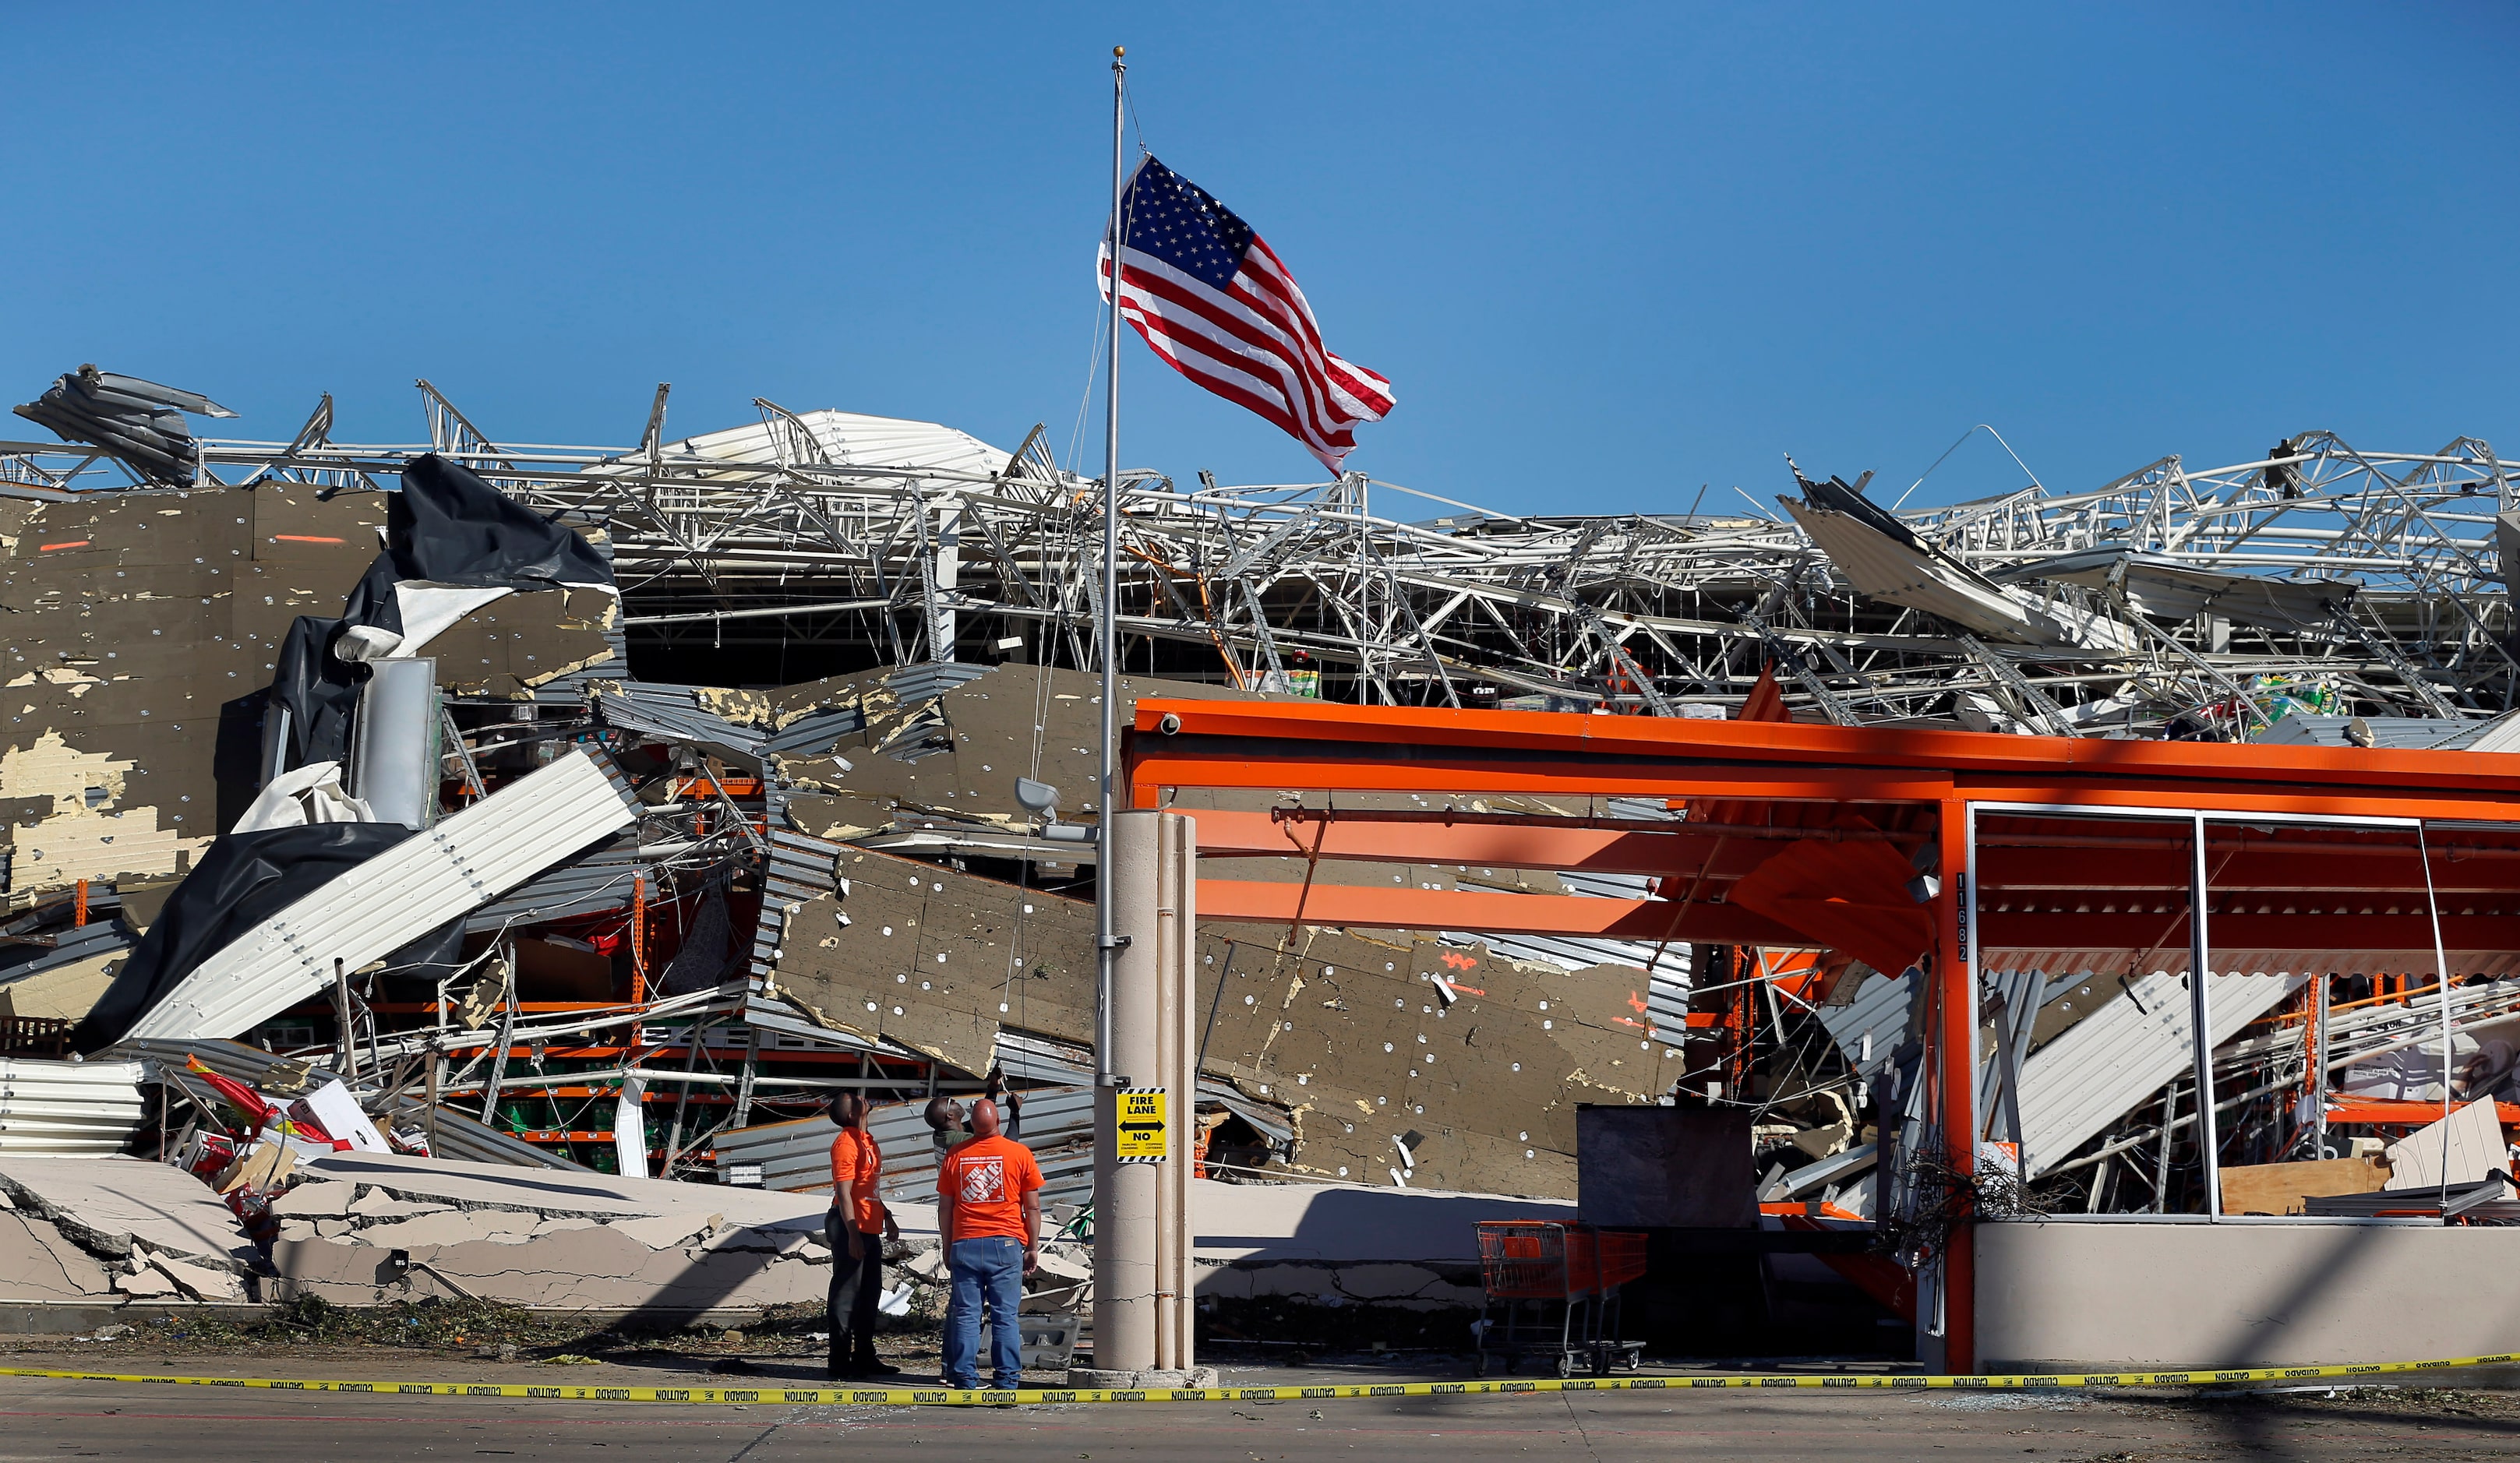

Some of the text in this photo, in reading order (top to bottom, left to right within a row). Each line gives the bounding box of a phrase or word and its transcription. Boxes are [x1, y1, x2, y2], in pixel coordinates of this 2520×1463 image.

[962, 1163, 1000, 1201] HOME
[965, 1166, 982, 1183] THE
[977, 1176, 1002, 1201] DEPOT
[339, 1384, 372, 1392] CUIDADO
[399, 1385, 432, 1394] CAUTION
[468, 1387, 501, 1396] CUIDADO
[528, 1387, 560, 1398] CAUTION
[596, 1389, 630, 1399] CUIDADO
[656, 1390, 689, 1400] CAUTION
[725, 1391, 758, 1401] CUIDADO
[785, 1391, 817, 1401] CAUTION
[853, 1392, 887, 1402] CUIDADO
[913, 1392, 947, 1401] CAUTION
[982, 1392, 1016, 1401] CUIDADO
[1043, 1392, 1075, 1401] CAUTION
[1111, 1391, 1145, 1401] CUIDADO
[1172, 1391, 1205, 1401] CAUTION
[1241, 1390, 1275, 1399] CUIDADO
[1301, 1388, 1335, 1398] CAUTION
[1371, 1387, 1404, 1396] CUIDADO
[1431, 1384, 1465, 1394] CAUTION
[1501, 1383, 1535, 1392] CUIDADO
[1562, 1381, 1595, 1391] CAUTION
[1631, 1380, 1665, 1389] CUIDADO
[1762, 1379, 1796, 1387] CUIDADO
[1823, 1378, 1857, 1387] CAUTION
[1892, 1378, 1927, 1387] CUIDADO
[1954, 1378, 1988, 1387] CAUTION
[2024, 1377, 2057, 1386] CUIDADO
[2084, 1377, 2118, 1385] CAUTION
[2155, 1374, 2189, 1384] CUIDADO
[2215, 1372, 2249, 1381] CAUTION
